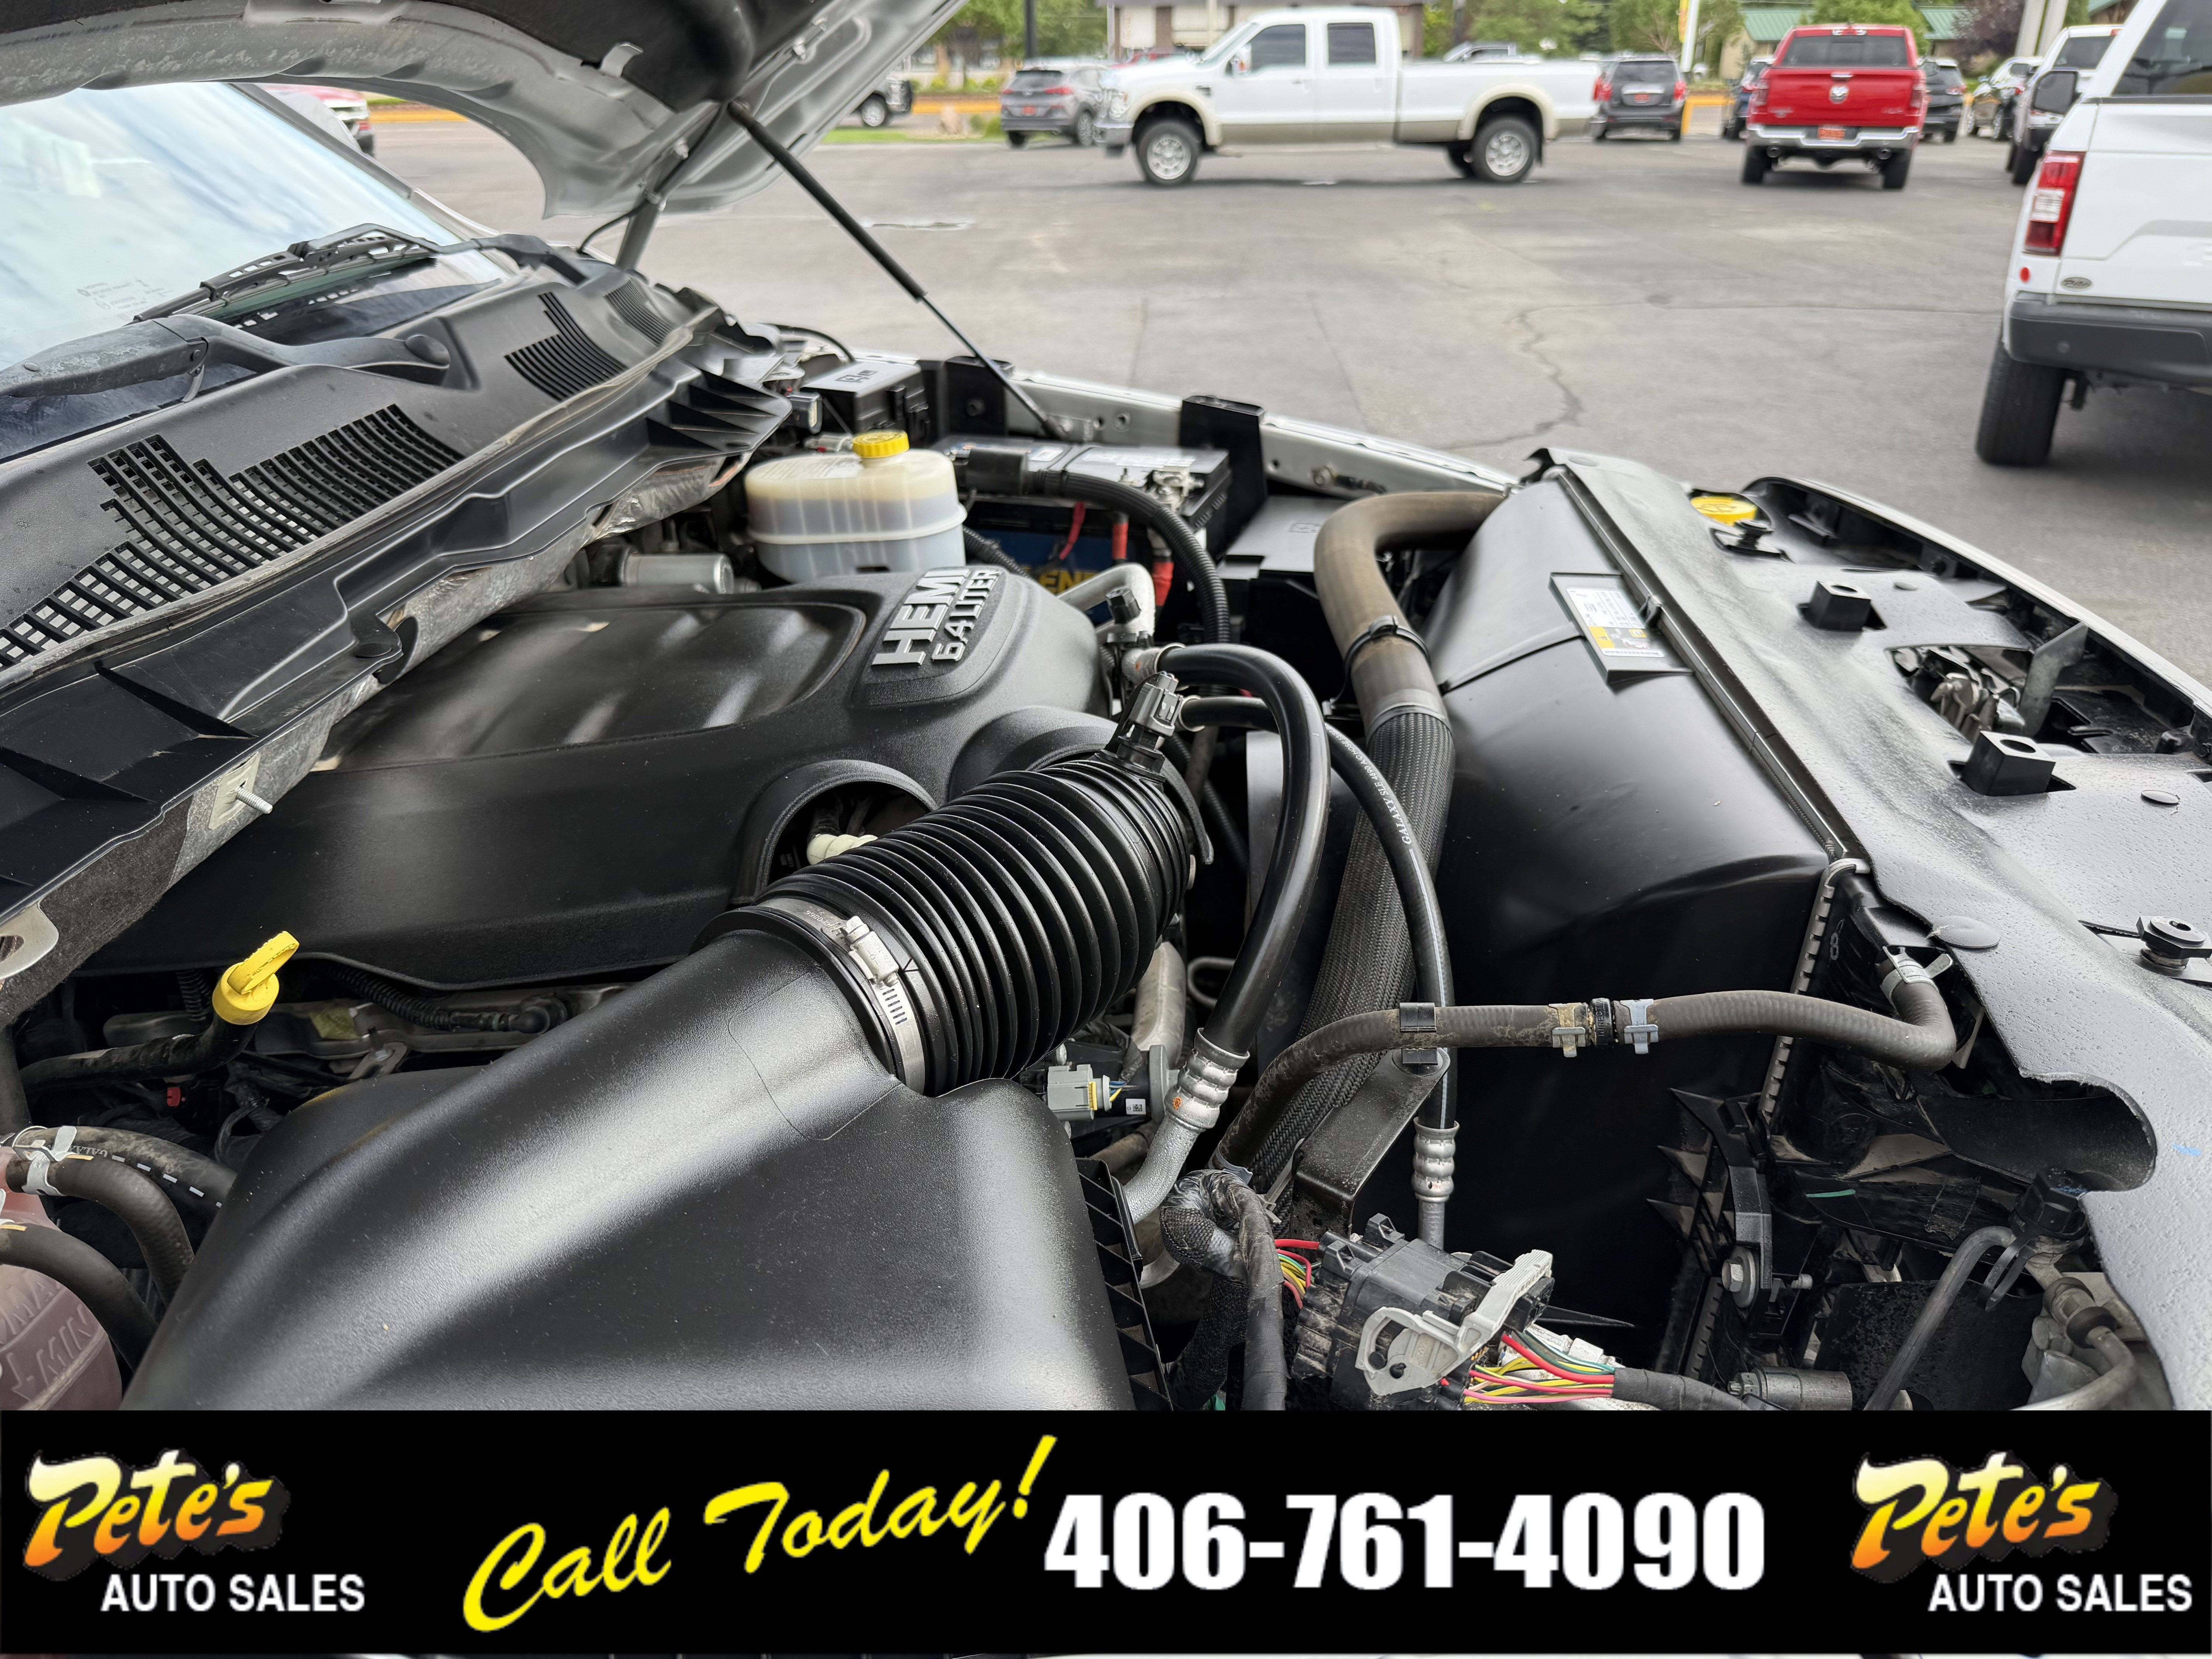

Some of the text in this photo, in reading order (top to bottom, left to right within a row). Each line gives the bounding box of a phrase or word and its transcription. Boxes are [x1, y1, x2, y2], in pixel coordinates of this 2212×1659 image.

[871, 569, 970, 667] HEMI
[1364, 766, 1378, 780] 4890
[1374, 781, 1389, 796] SLE
[1383, 797, 1412, 844] GALAXY
